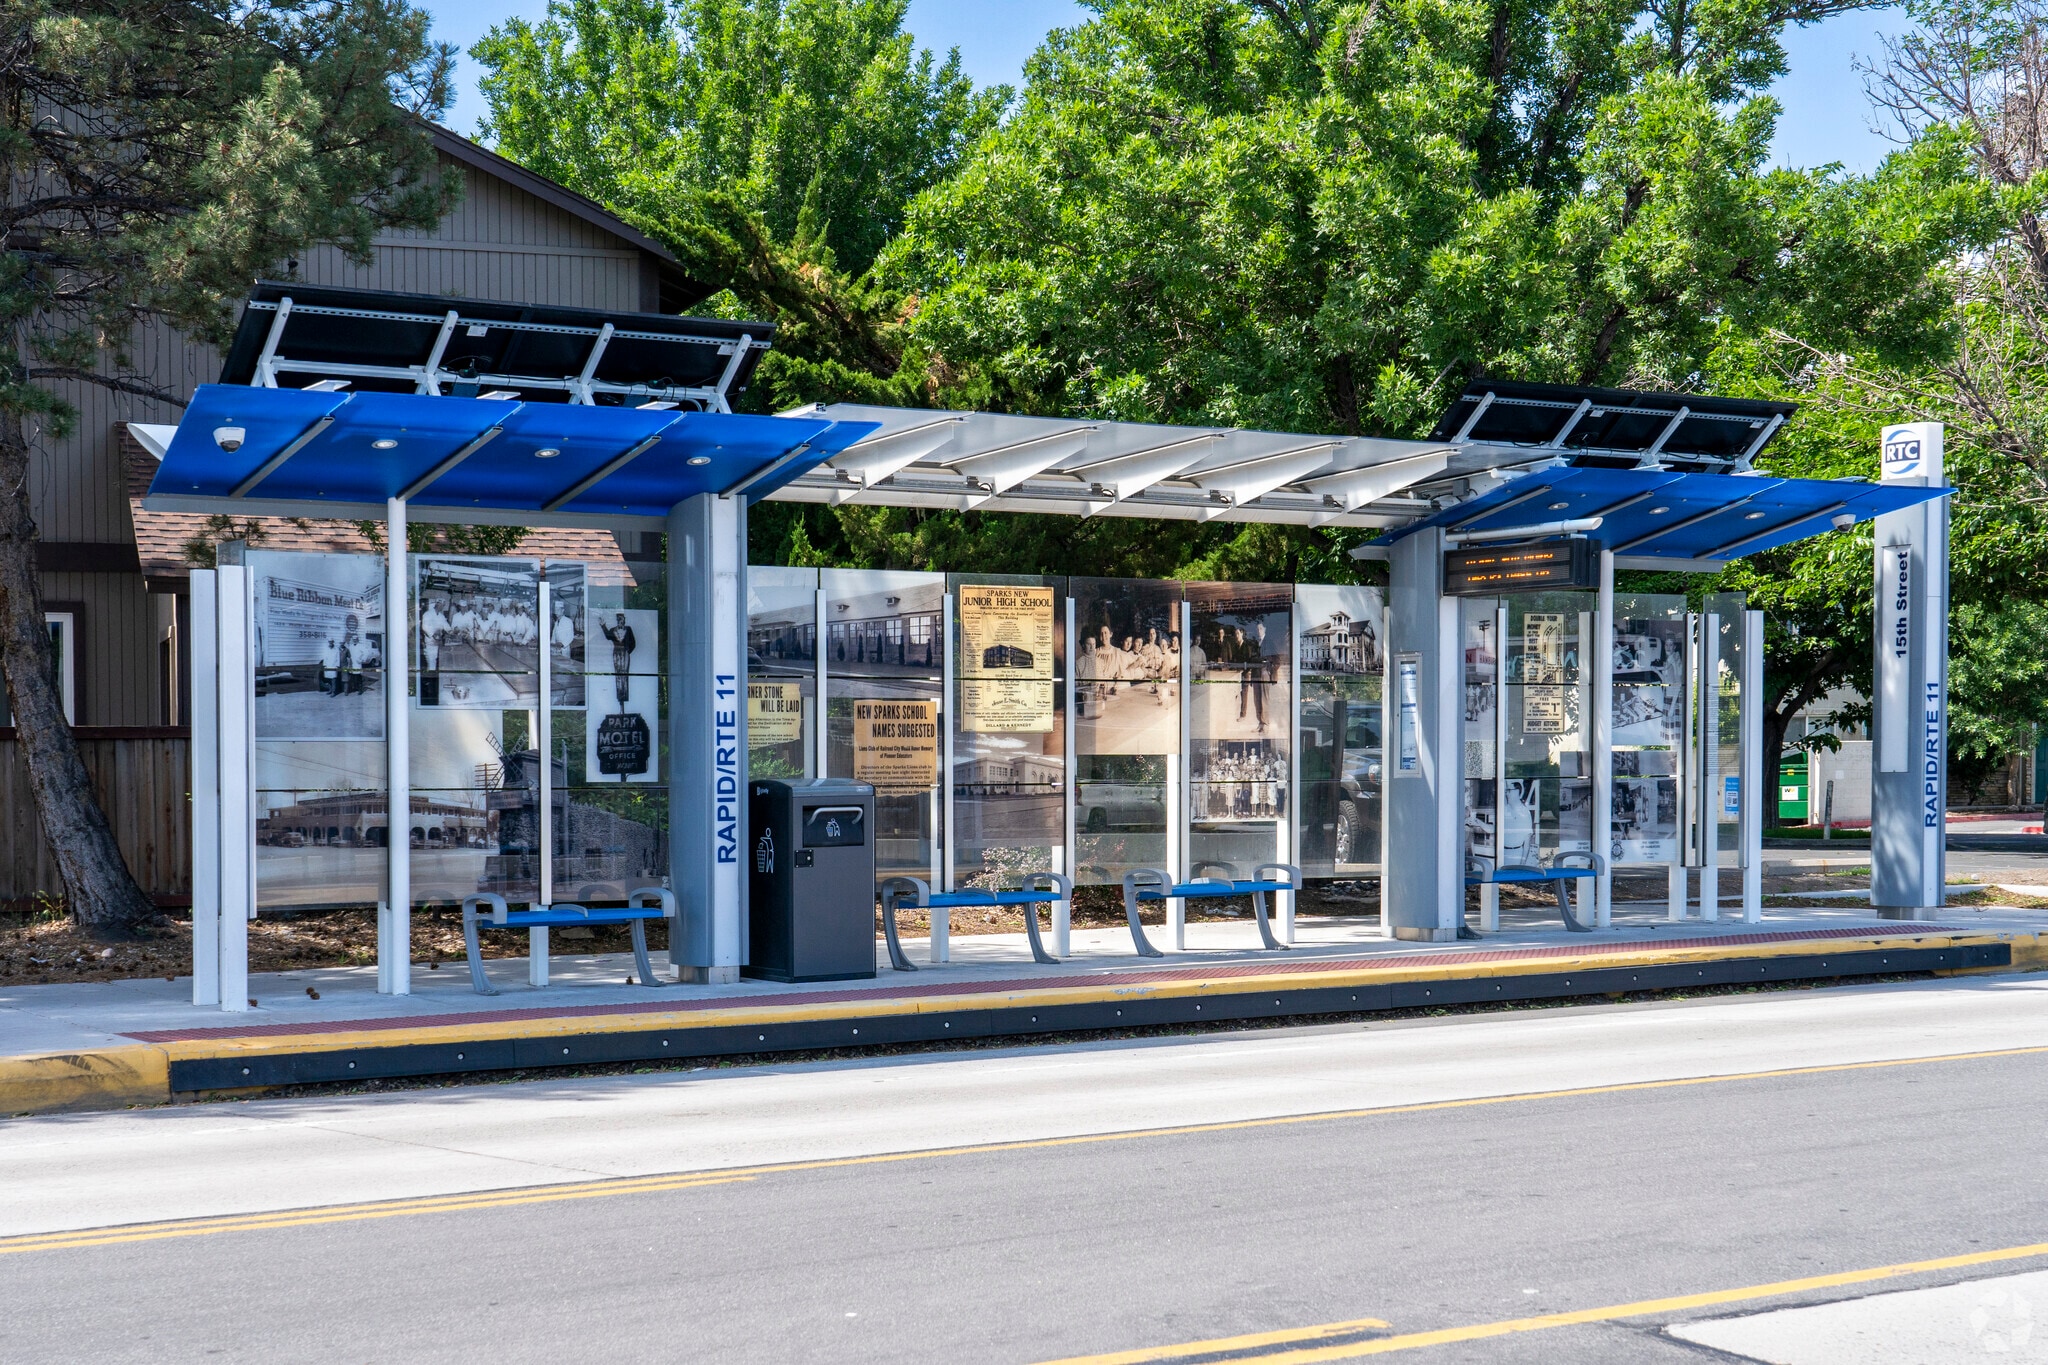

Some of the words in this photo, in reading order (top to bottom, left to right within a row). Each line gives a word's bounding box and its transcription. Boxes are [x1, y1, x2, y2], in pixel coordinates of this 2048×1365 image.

[1886, 442, 1919, 461] RTC
[1896, 552, 1908, 611] Street
[270, 581, 294, 600] Blue
[296, 588, 332, 606] Ribbon
[334, 595, 353, 608] Meat
[963, 597, 992, 606] JUNIOR
[997, 598, 1016, 606] HIGH
[1021, 598, 1052, 607] SCHOOL
[1896, 617, 1907, 658] 15th
[716, 675, 735, 699] 11
[764, 686, 783, 698] STONE
[1927, 683, 1938, 702] 11
[761, 700, 775, 712] WILL
[777, 700, 784, 712] BE
[786, 700, 799, 712] LAID
[857, 705, 871, 720] NEW
[874, 705, 900, 720] SPARKS
[903, 705, 928, 720] SCHOOL
[608, 717, 636, 729] PARK
[873, 724, 895, 738] NAMES
[898, 724, 935, 738] SUGGESTED
[600, 732, 645, 745] MOTEL
[1925, 710, 1938, 828] RAPID/RTE
[716, 711, 736, 863] RAPID/RTE
